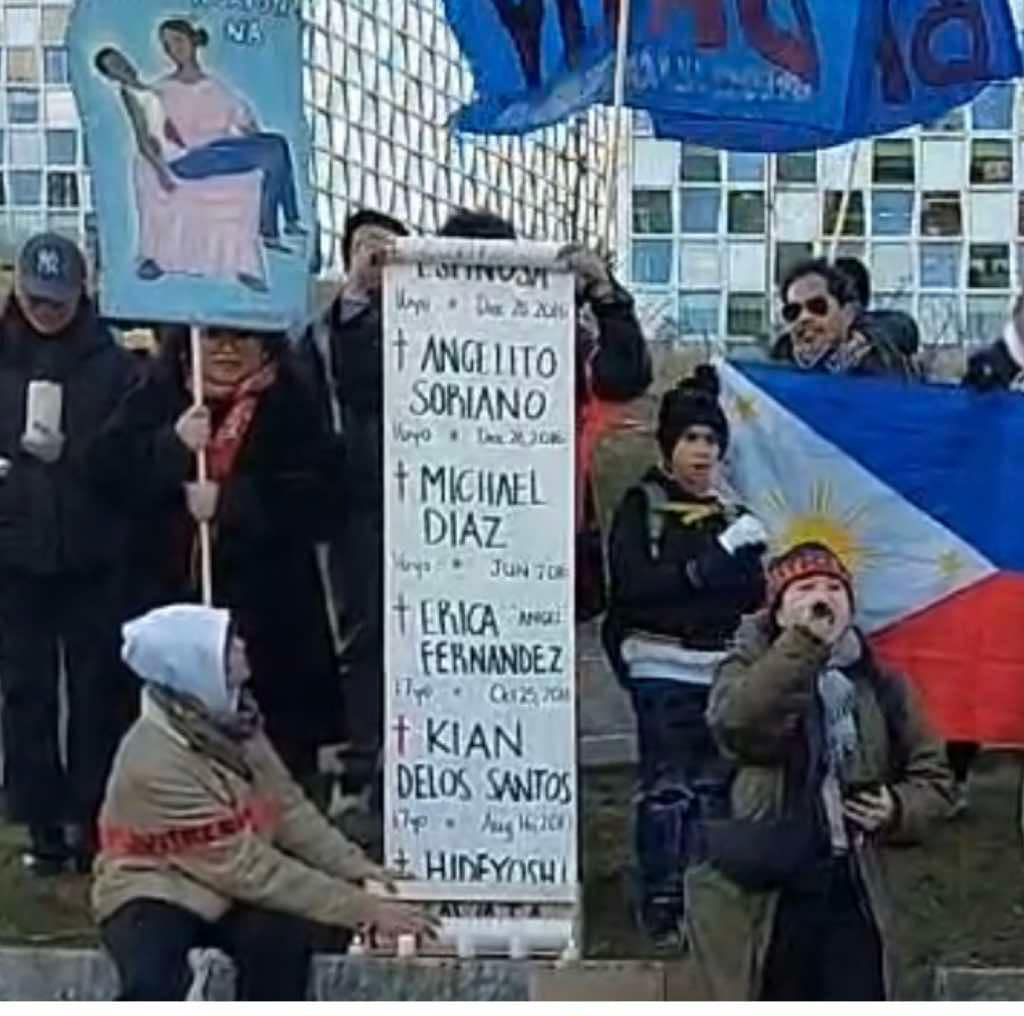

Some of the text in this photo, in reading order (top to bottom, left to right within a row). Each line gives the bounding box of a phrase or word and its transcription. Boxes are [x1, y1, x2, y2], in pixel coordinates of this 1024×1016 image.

[420, 333, 558, 379] ANGELITO
[408, 379, 547, 421] SORIANO
[420, 463, 547, 507] MICHAEL
[423, 506, 508, 549] DIAZ
[420, 598, 500, 637] ERICA
[420, 640, 564, 676] FERNANDEZ
[425, 717, 524, 760] KIAN
[397, 762, 572, 805] DELOS SANTOS
